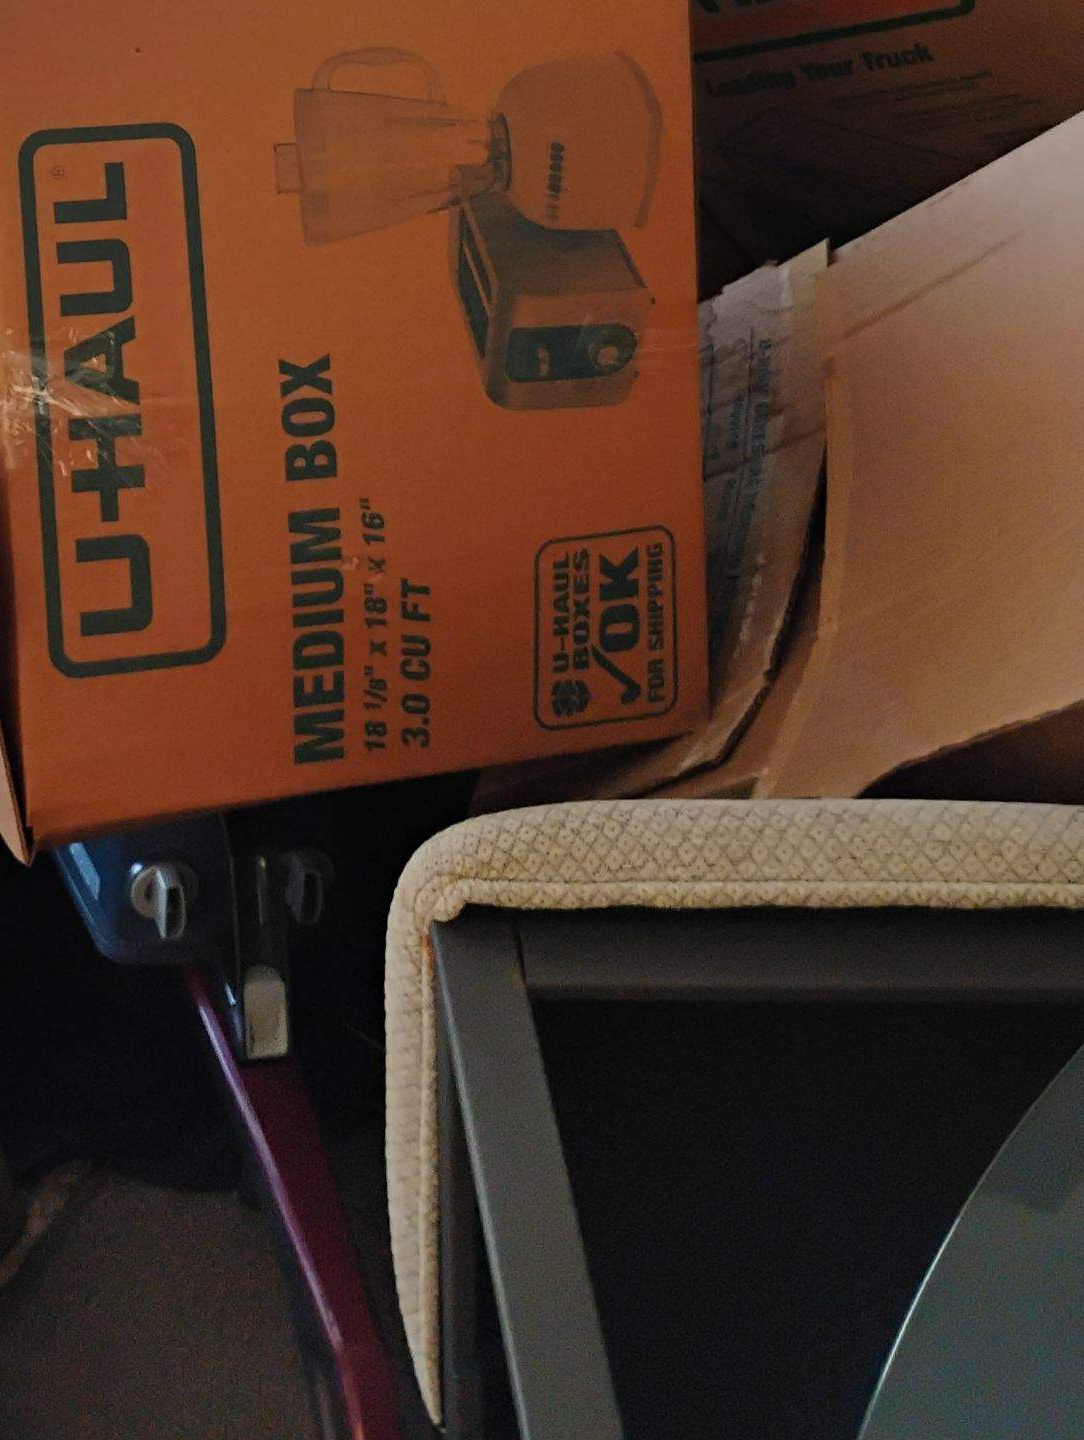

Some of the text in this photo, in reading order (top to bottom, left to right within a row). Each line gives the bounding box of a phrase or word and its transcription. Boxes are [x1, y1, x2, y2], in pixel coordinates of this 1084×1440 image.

[861, 43, 934, 71] Truck
[278, 354, 345, 765] MEDIUM BOX
[553, 552, 569, 674] U-HAUL
[573, 548, 590, 670] BOXES
[599, 546, 640, 653] OK
[400, 578, 431, 748] 3.0 CU FT
[647, 542, 664, 702] FOR SHIPPING
